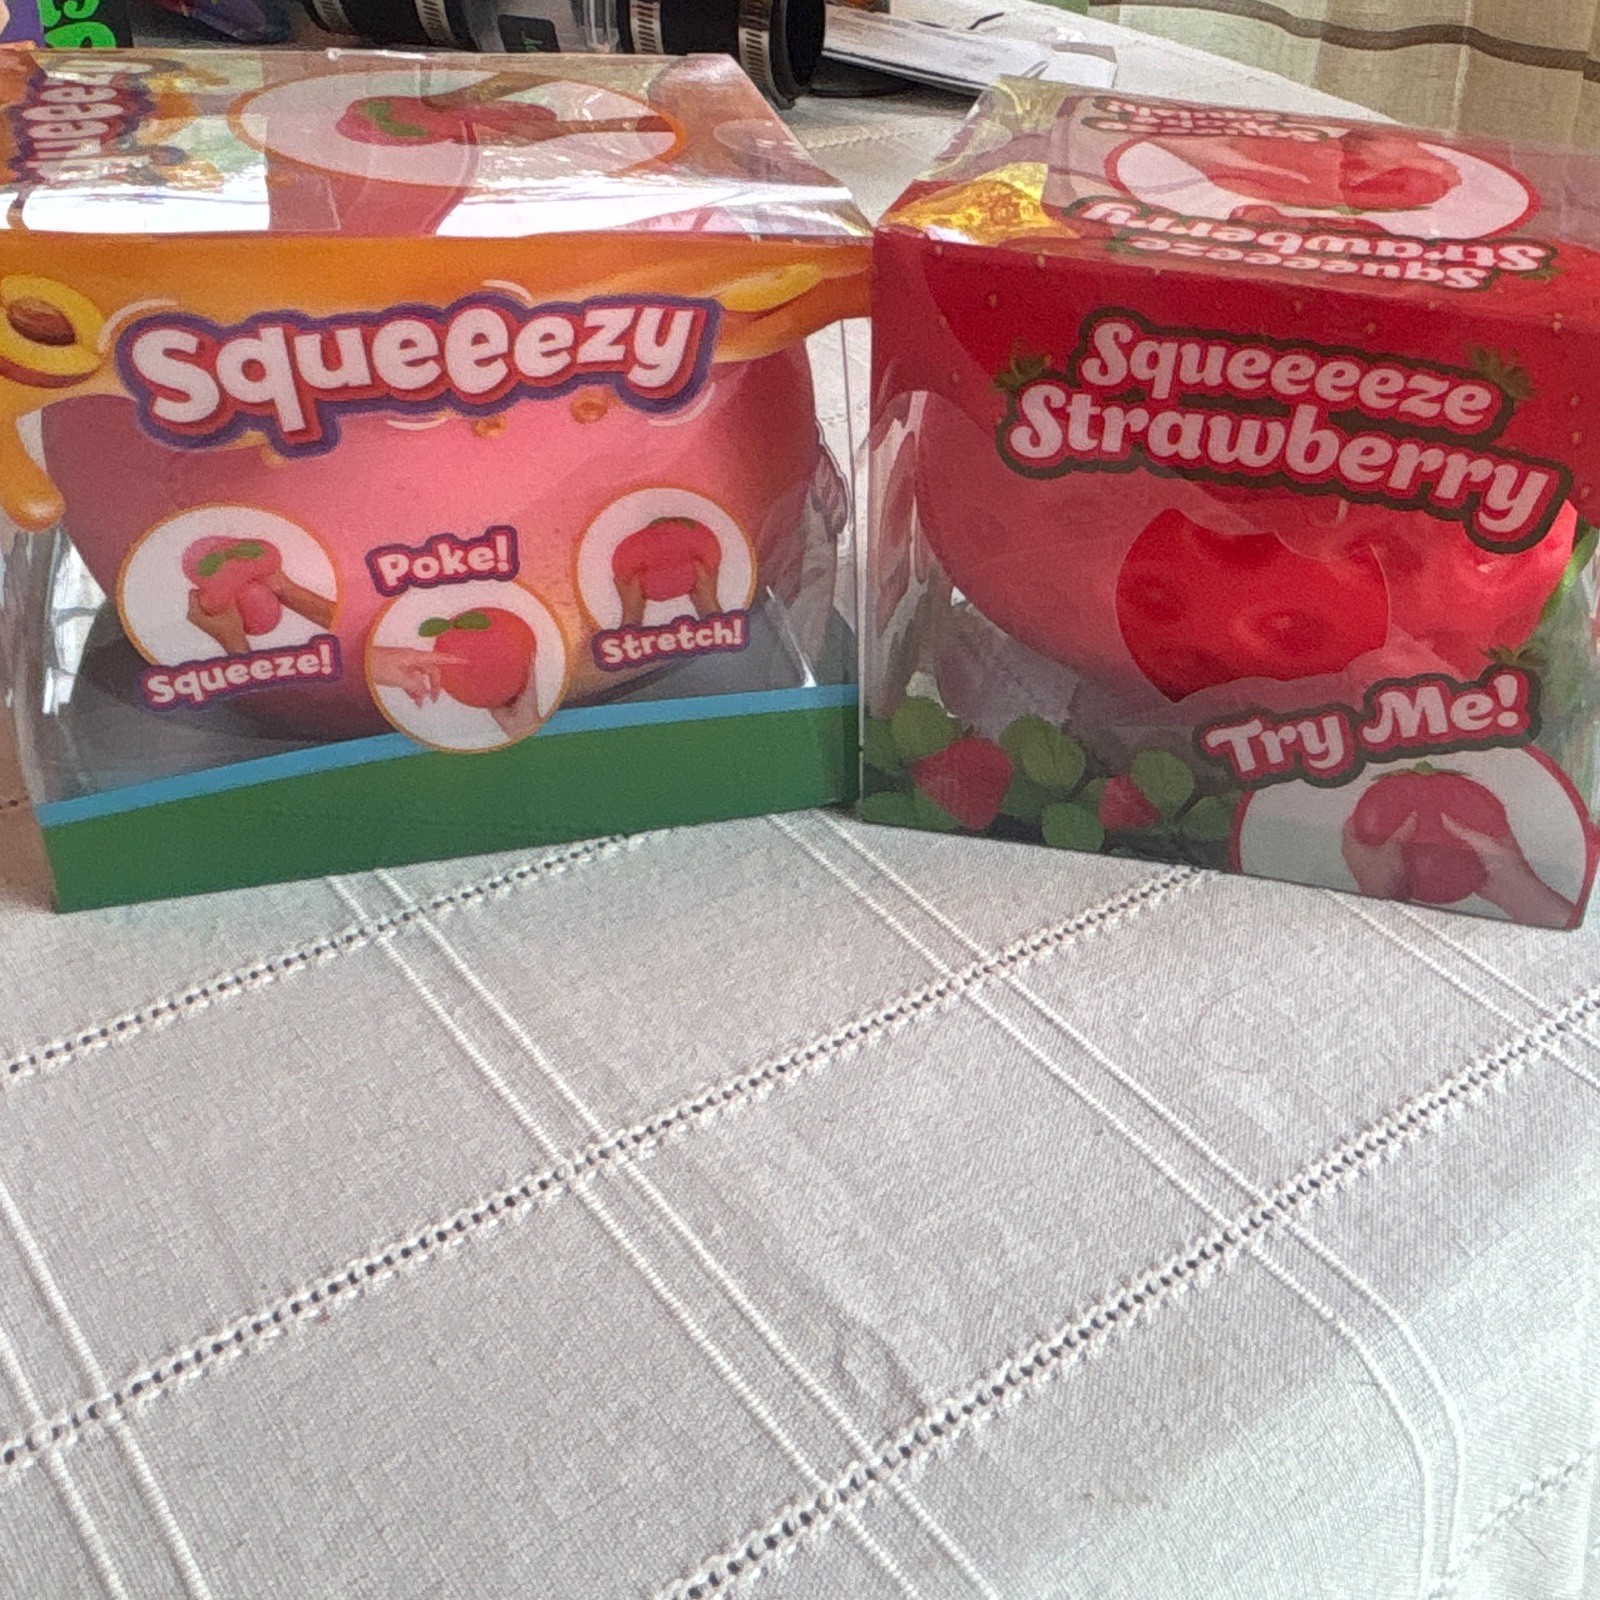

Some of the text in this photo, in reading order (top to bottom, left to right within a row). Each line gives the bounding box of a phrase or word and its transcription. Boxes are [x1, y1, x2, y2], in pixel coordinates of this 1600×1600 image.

[1080, 201, 1546, 272] Strawberry
[1129, 236, 1488, 291] Squeeeeze
[131, 306, 695, 433] Squeeezy
[1082, 321, 1492, 426] Squeeeeze
[1009, 383, 1549, 534] Strawberry
[376, 535, 510, 590] Poke!
[145, 642, 333, 704] Squeeze!
[601, 611, 744, 665] Stretch!
[1205, 674, 1519, 773] Try Me!
